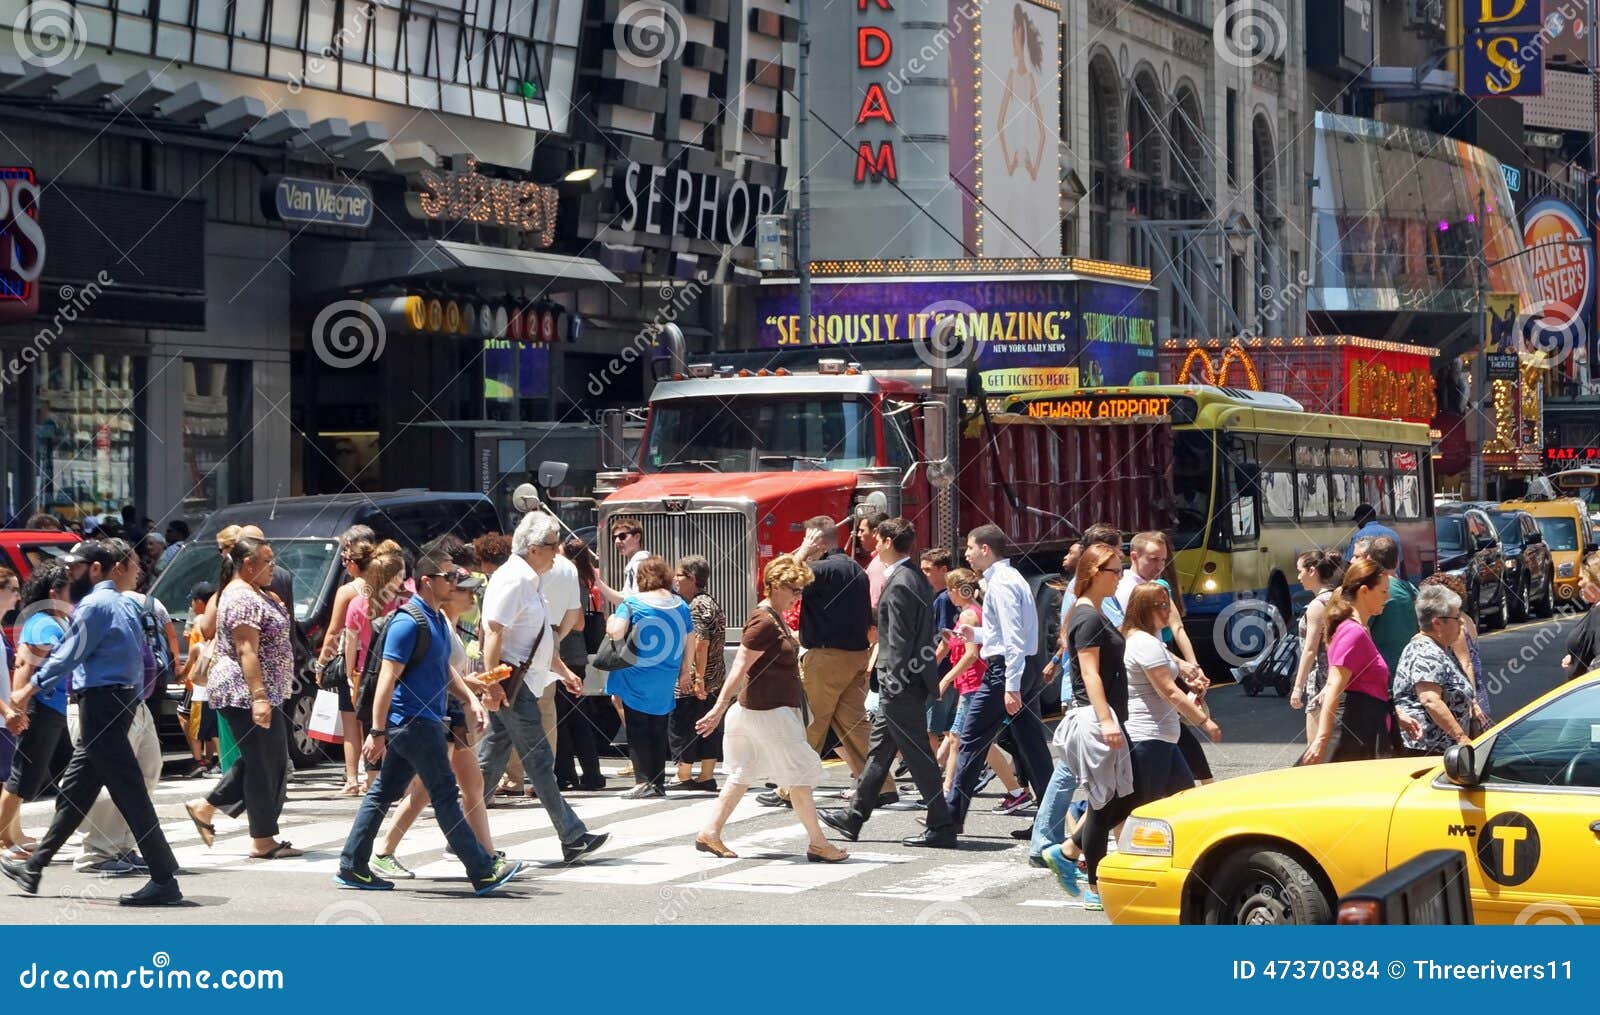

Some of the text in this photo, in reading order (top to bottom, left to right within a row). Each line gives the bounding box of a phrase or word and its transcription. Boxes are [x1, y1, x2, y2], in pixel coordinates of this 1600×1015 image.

[855, 0, 898, 184] DAM
[285, 184, 367, 220] Van Wagner
[993, 343, 1066, 353] NEW YORK DAILY NEWS
[988, 373, 1071, 387] GET TICKETS HERE
[1028, 398, 1169, 418] NEWARK AIRPORT
[1447, 824, 1528, 877] NYC T
